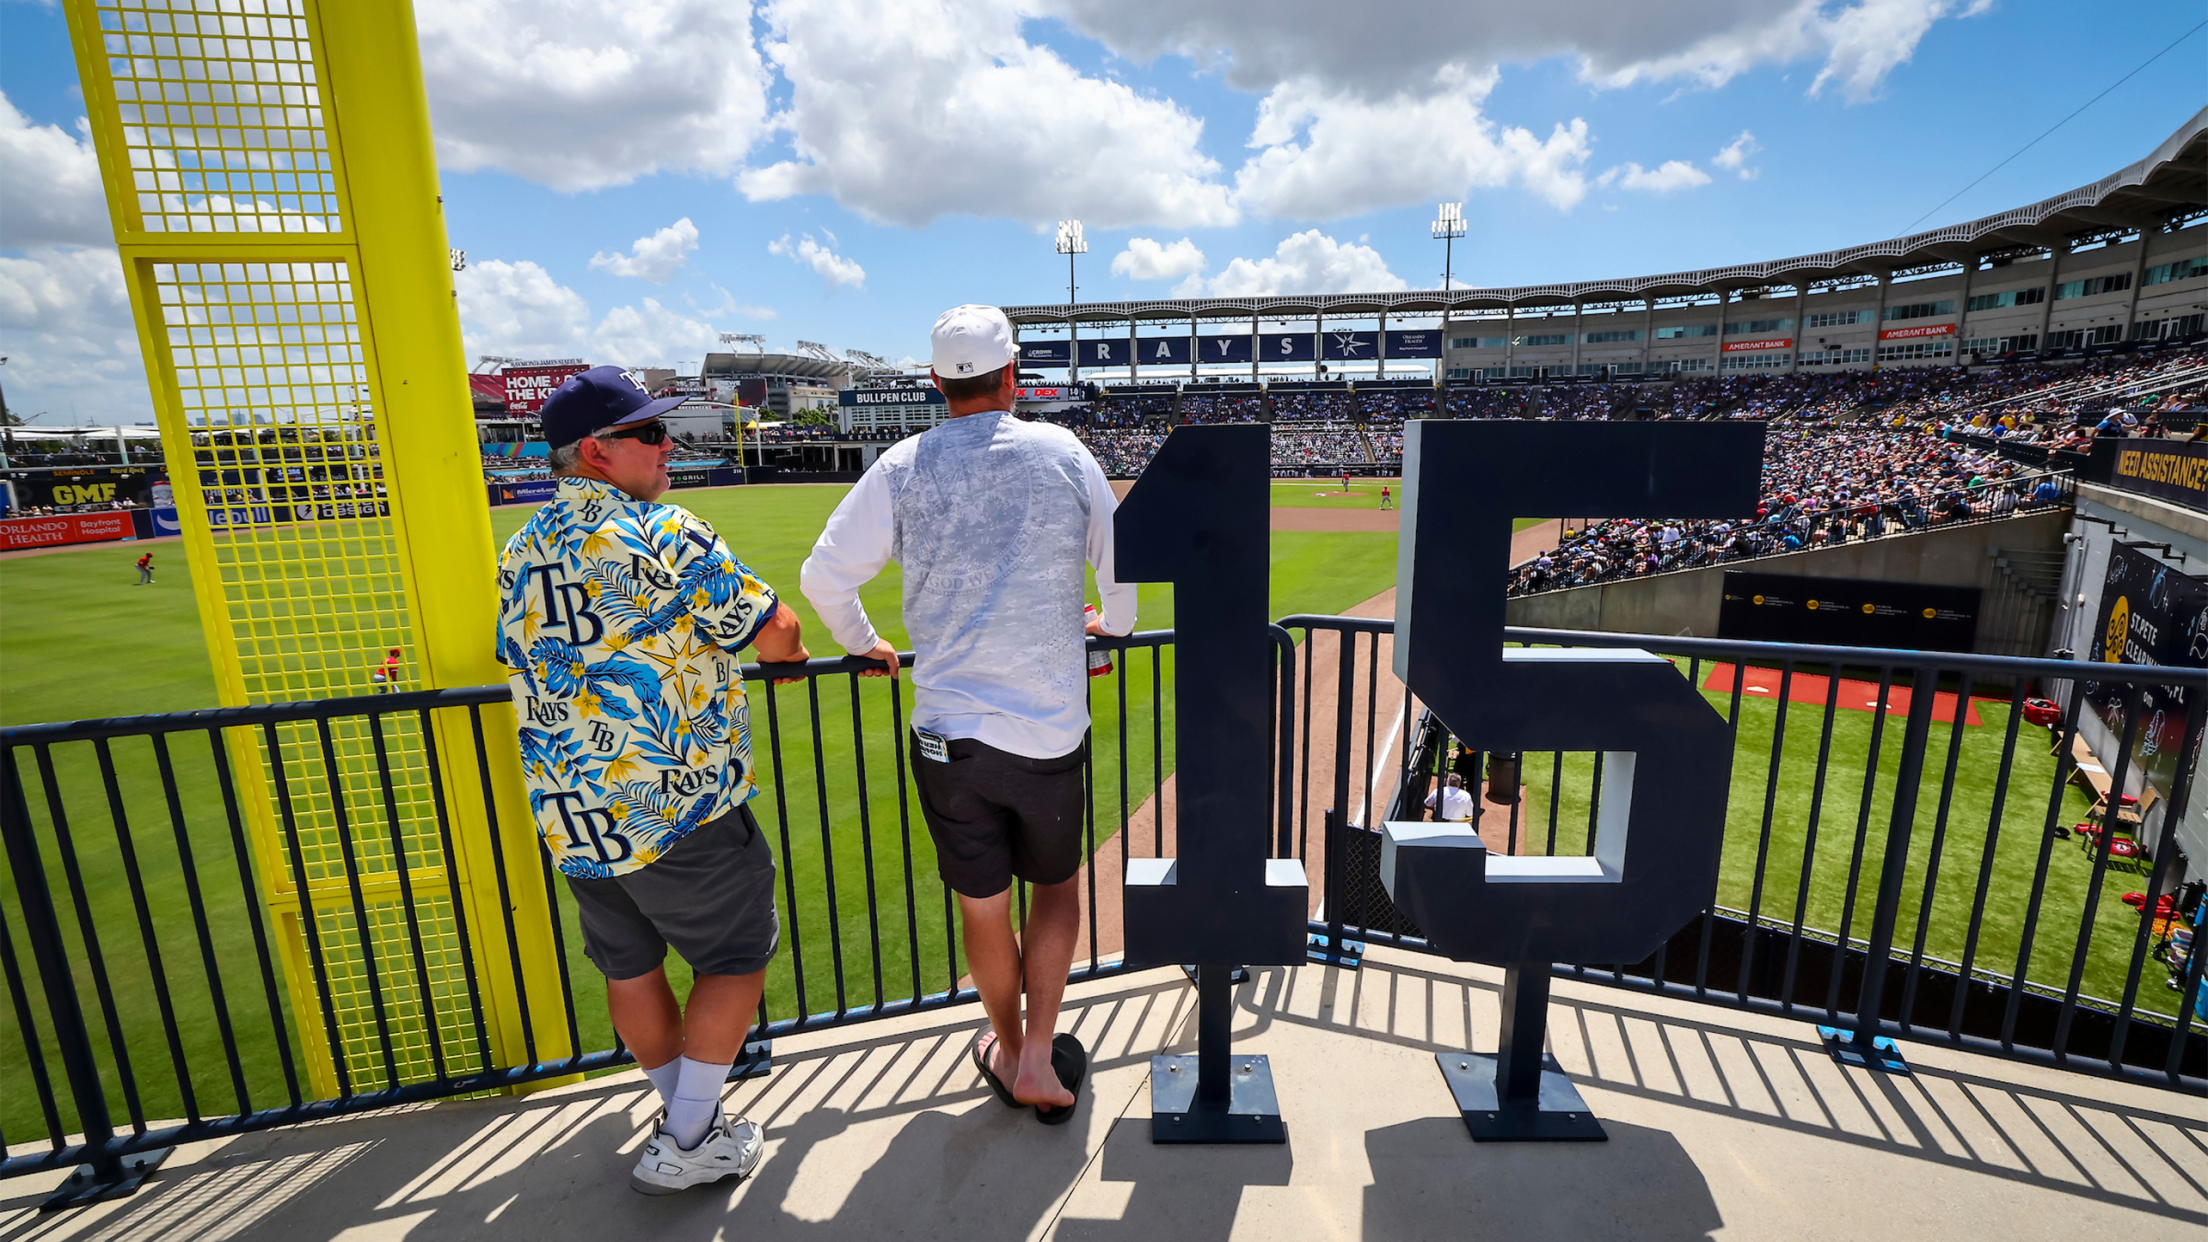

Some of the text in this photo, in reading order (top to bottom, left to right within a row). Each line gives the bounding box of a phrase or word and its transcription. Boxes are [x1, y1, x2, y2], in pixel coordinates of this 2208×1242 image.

[1886, 326, 1948, 338] AMERANT BANK
[1728, 340, 1785, 350] AMERANT BANK
[510, 360, 540, 368] RAYMOND
[506, 375, 552, 388] HOME
[505, 388, 535, 401] THE
[856, 392, 926, 404] BULLPEN CLUB
[1034, 388, 1058, 396] DEX
[2118, 450, 2142, 477] NEED
[52, 482, 116, 504] GMF
[0, 521, 68, 535] ORLANDO
[80, 518, 122, 530] Bayfront
[82, 526, 121, 535] Hospital
[9, 532, 63, 544] HEALTH
[929, 576, 964, 589] GOD
[968, 570, 994, 586] WE
[997, 527, 1031, 572] TRUST
[527, 562, 604, 646] TB
[2130, 612, 2158, 646] ST.PETE
[526, 696, 569, 727] RAYS
[588, 720, 615, 752] TB
[658, 764, 718, 797] RAYS
[540, 790, 632, 864] TB
